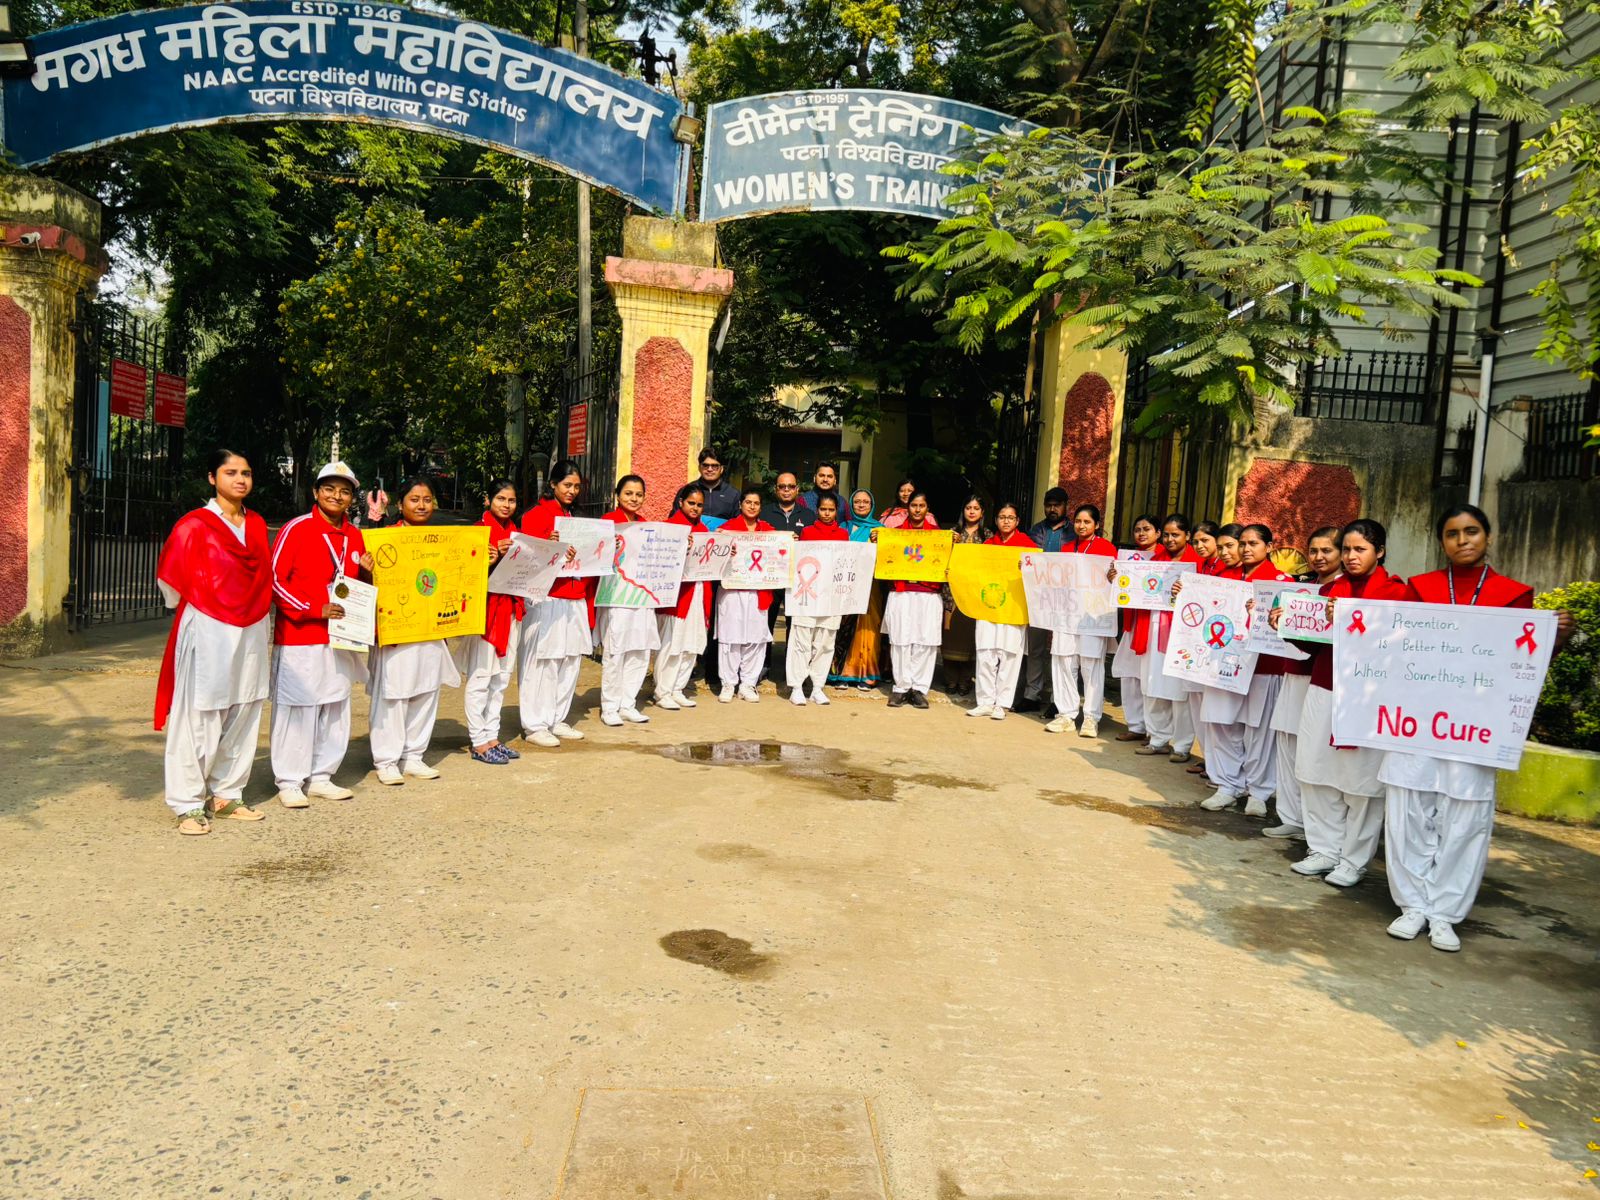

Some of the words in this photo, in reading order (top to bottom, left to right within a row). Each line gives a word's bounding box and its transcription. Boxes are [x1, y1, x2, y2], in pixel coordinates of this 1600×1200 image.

[354, 5, 402, 22] 1946
[31, 29, 147, 92] मगध
[156, 5, 336, 64] महिला
[348, 18, 664, 140] महाविद्यालय
[184, 66, 254, 91] NAAC
[262, 66, 369, 86] Accredited
[376, 74, 417, 94] With
[421, 80, 465, 105] CPE
[468, 91, 528, 122] Status
[249, 88, 296, 106] पटना
[428, 103, 470, 127] पटना
[722, 104, 839, 147] वीमेन्स
[849, 96, 965, 146] ट्रेनिंग
[780, 144, 830, 161] पटना
[713, 172, 855, 209] WOMEN'S
[423, 534, 438, 544] AIDS
[835, 558, 857, 570] SAY
[833, 572, 844, 583] NO
[847, 571, 856, 582] TO
[1034, 561, 1106, 589] WORLD
[1040, 588, 1079, 613] AIDS
[1290, 599, 1324, 616] STOP
[1285, 613, 1325, 632] AIDS
[1392, 612, 1460, 632] Prevention
[1402, 638, 1436, 653] Better
[1440, 639, 1463, 654] than
[1471, 643, 1497, 657] Cure
[1353, 661, 1388, 679] When
[1404, 662, 1467, 688] Something
[1473, 671, 1495, 688] Has
[1514, 672, 1537, 681] 2025
[1376, 704, 1418, 738] No
[1431, 710, 1492, 744] Cure
